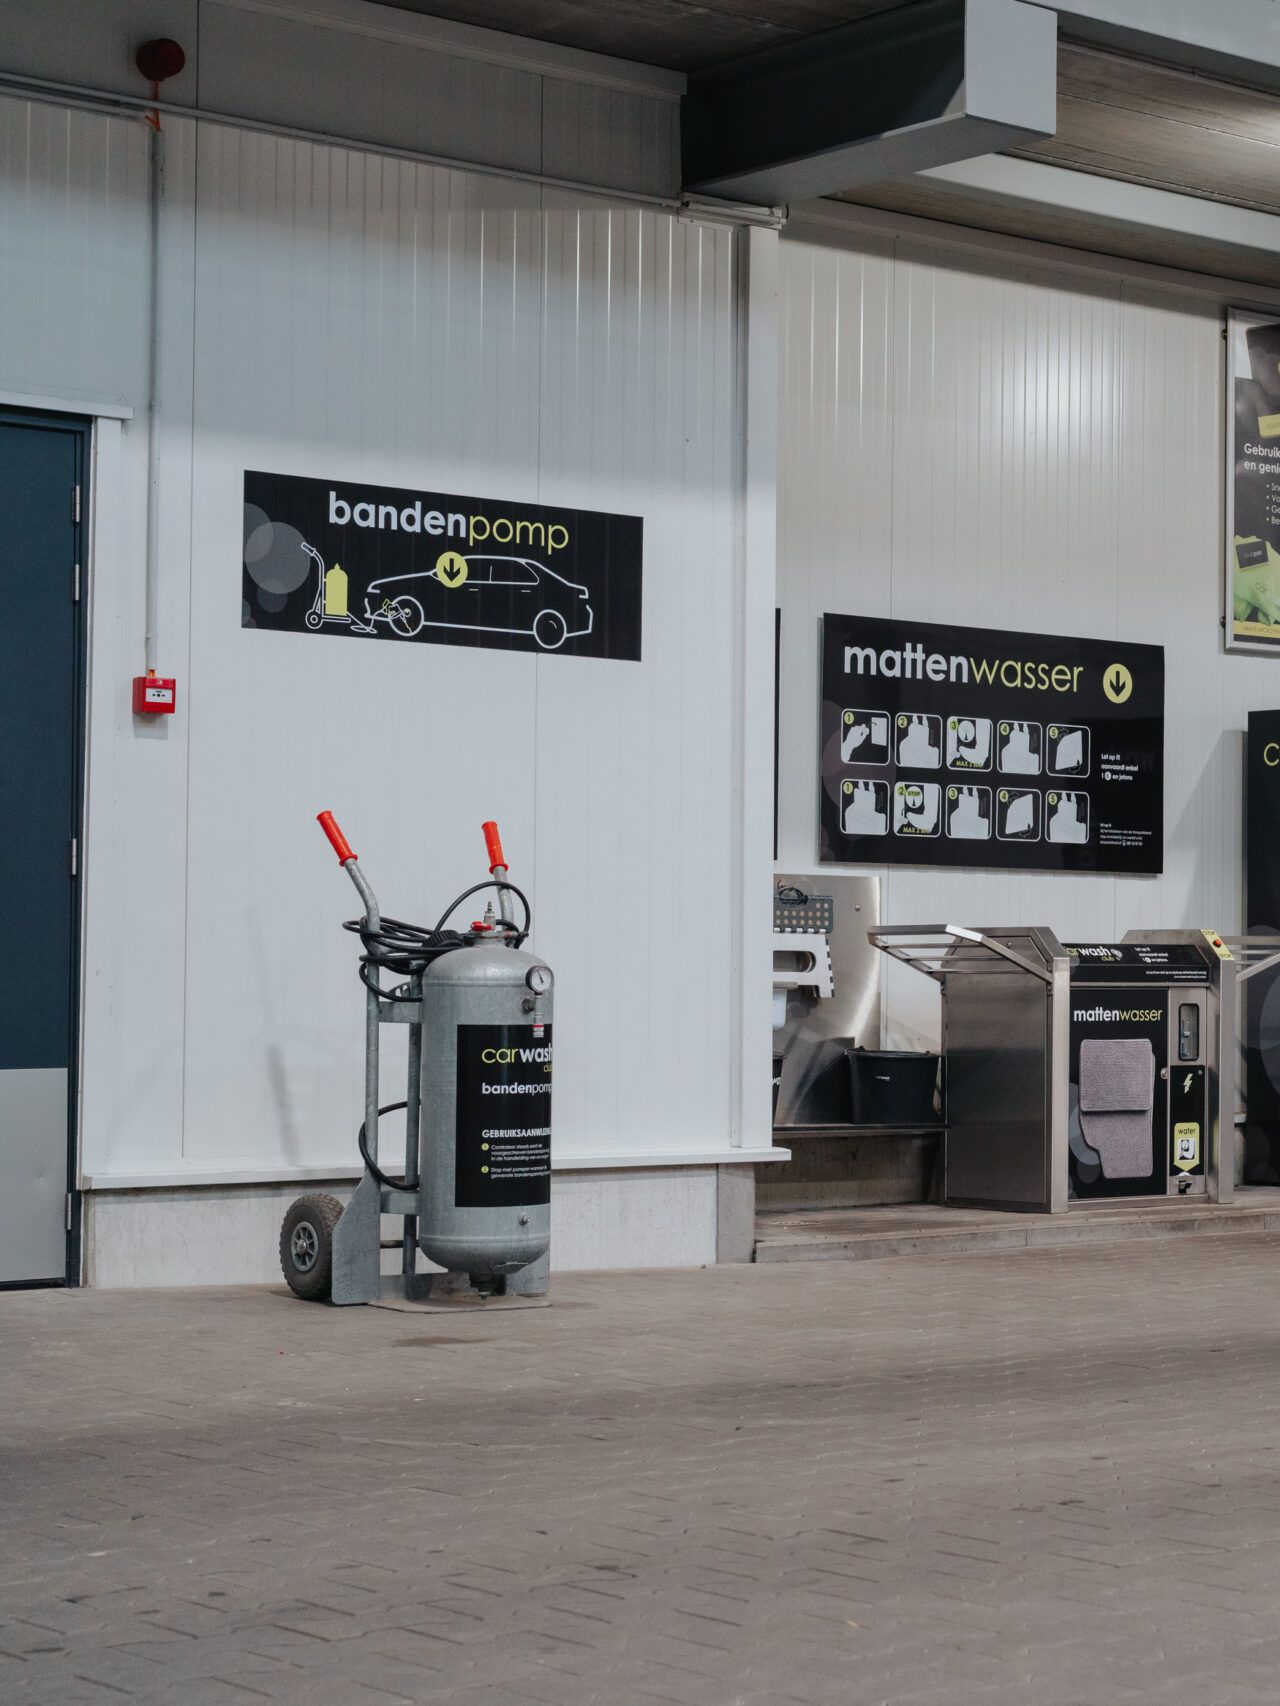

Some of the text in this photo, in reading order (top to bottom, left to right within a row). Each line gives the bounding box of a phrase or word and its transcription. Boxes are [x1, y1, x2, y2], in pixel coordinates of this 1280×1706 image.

[1244, 443, 1280, 458] Gebruik
[1244, 461, 1256, 470] en
[329, 491, 569, 554] bandenpomp
[844, 642, 1084, 693] mattenwasser
[1064, 946, 1112, 956] arwash
[1073, 1007, 1162, 1022] mattenwasser
[1178, 1126, 1196, 1135] water
